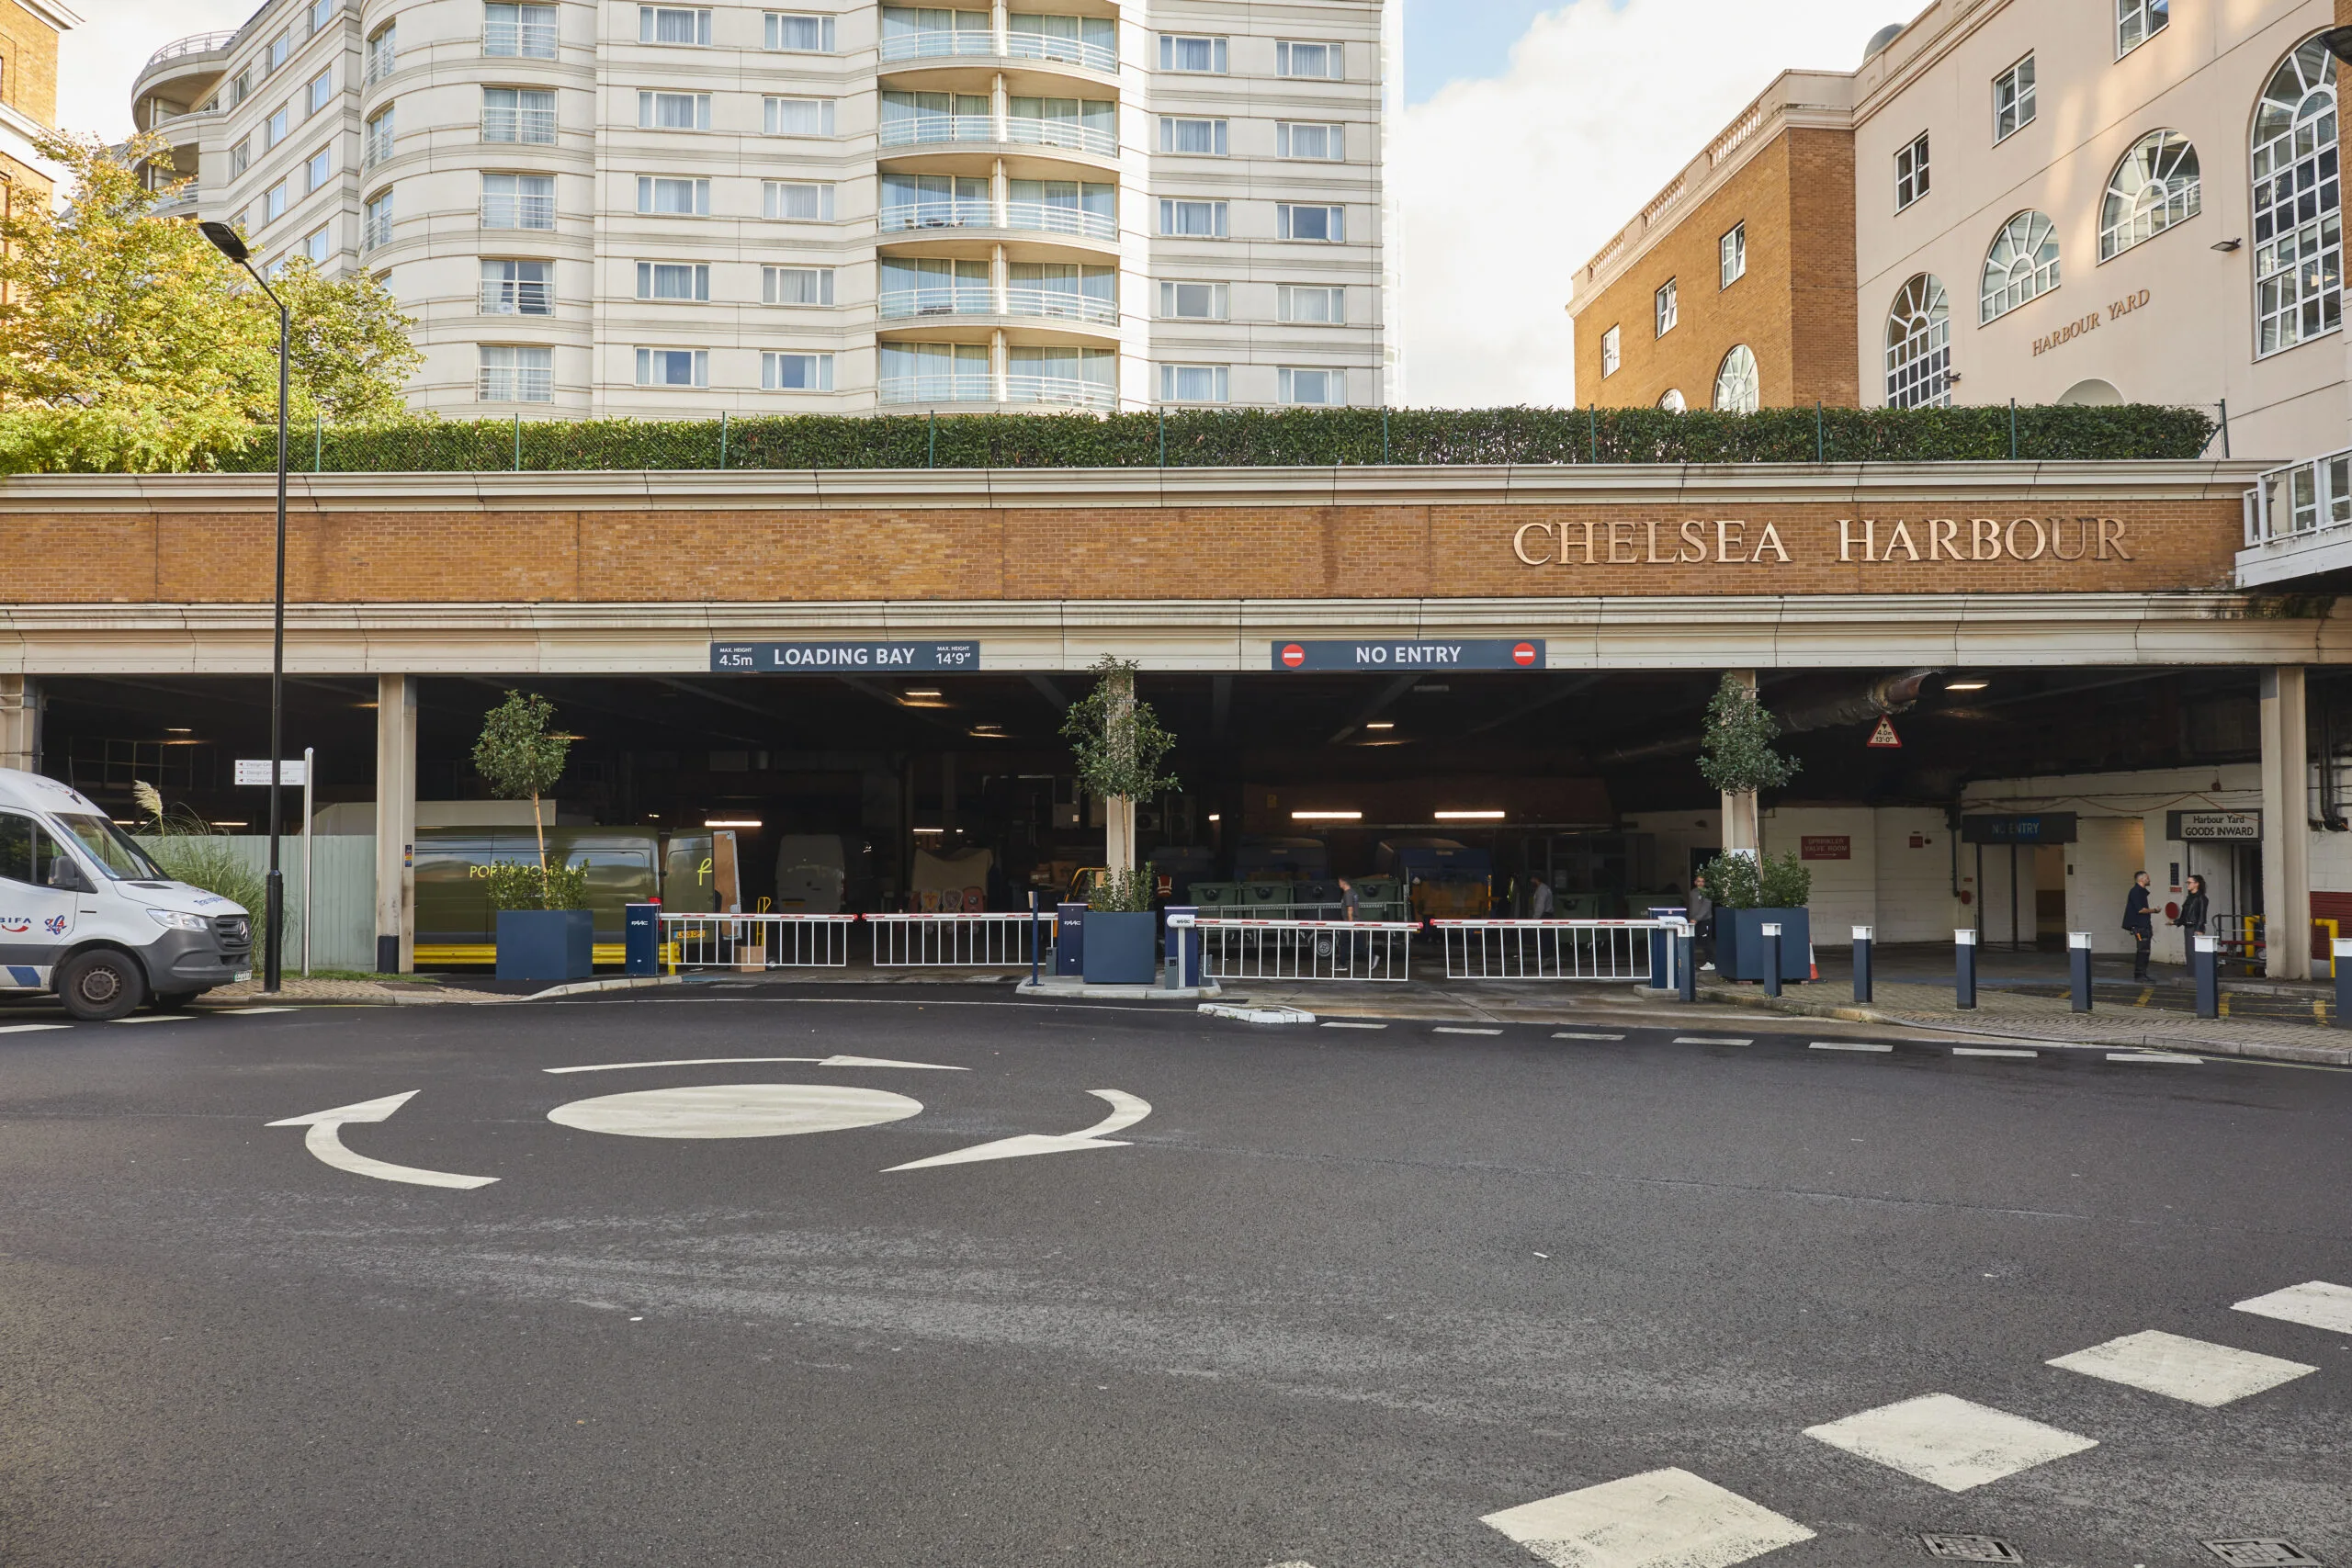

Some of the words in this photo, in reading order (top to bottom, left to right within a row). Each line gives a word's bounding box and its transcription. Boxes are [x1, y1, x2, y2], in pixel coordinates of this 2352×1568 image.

[2031, 311, 2101, 357] HARBOUR
[2107, 288, 2151, 321] YARD
[1513, 519, 1792, 566] CHELSEA
[1836, 517, 2134, 563] HARBOUR
[719, 655, 753, 667] 4.5m
[774, 648, 868, 665] LOADING
[876, 647, 916, 664] BAY
[1356, 647, 1387, 663] NO
[1396, 646, 1462, 662] ENTRY
[2193, 815, 2224, 824] Harbour
[2227, 815, 2245, 824] Yard
[1992, 823, 2006, 835] NO
[2008, 822, 2040, 835] ENTRY
[2185, 827, 2215, 836] GOODS
[2217, 826, 2255, 836] INWARD
